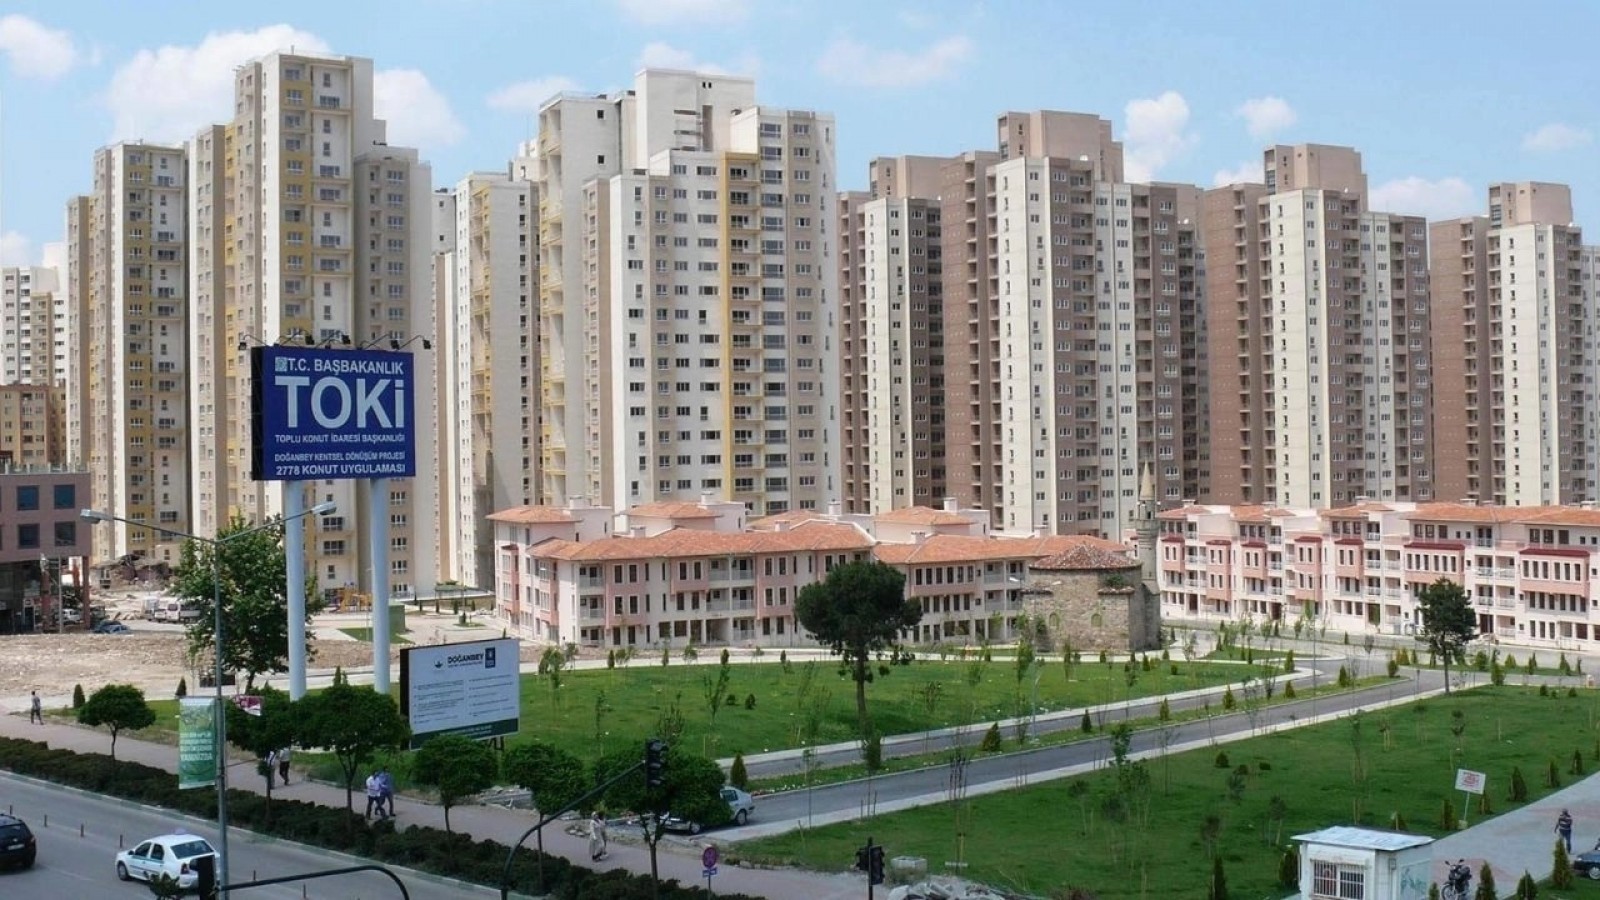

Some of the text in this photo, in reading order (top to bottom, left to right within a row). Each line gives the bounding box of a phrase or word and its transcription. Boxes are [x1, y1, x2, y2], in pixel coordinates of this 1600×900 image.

[288, 358, 404, 375] T.C. BAŞBAKANLIK
[275, 432, 405, 444] TOPLU KONUT İDARESİ BAŞKANLIĞI
[275, 451, 405, 461] DOĞANBEY KENTSEL DÖNÜŞÜM PROJESİ
[276, 463, 405, 476] 2778 KONUT UYGULAMASI
